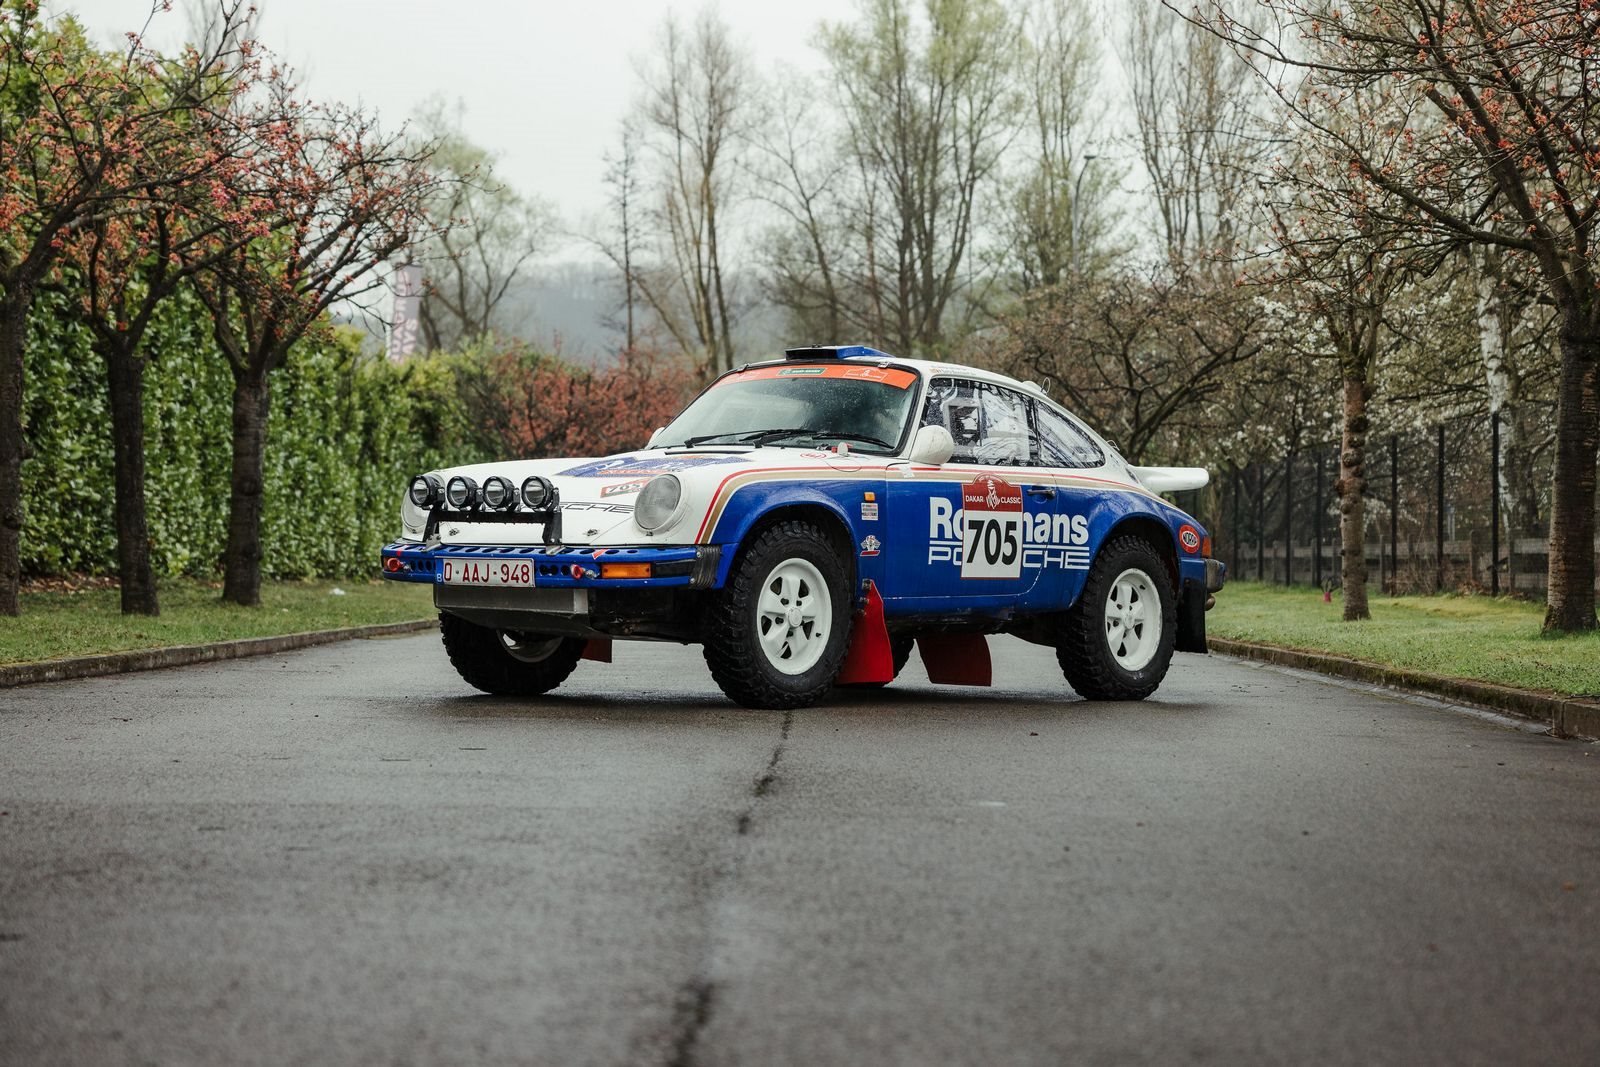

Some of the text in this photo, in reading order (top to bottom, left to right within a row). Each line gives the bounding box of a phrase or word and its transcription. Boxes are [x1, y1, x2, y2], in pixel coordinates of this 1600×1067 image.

[965, 495, 1022, 504] DAKAR CLASSIC
[966, 518, 1018, 566] 705
[436, 573, 443, 583] B
